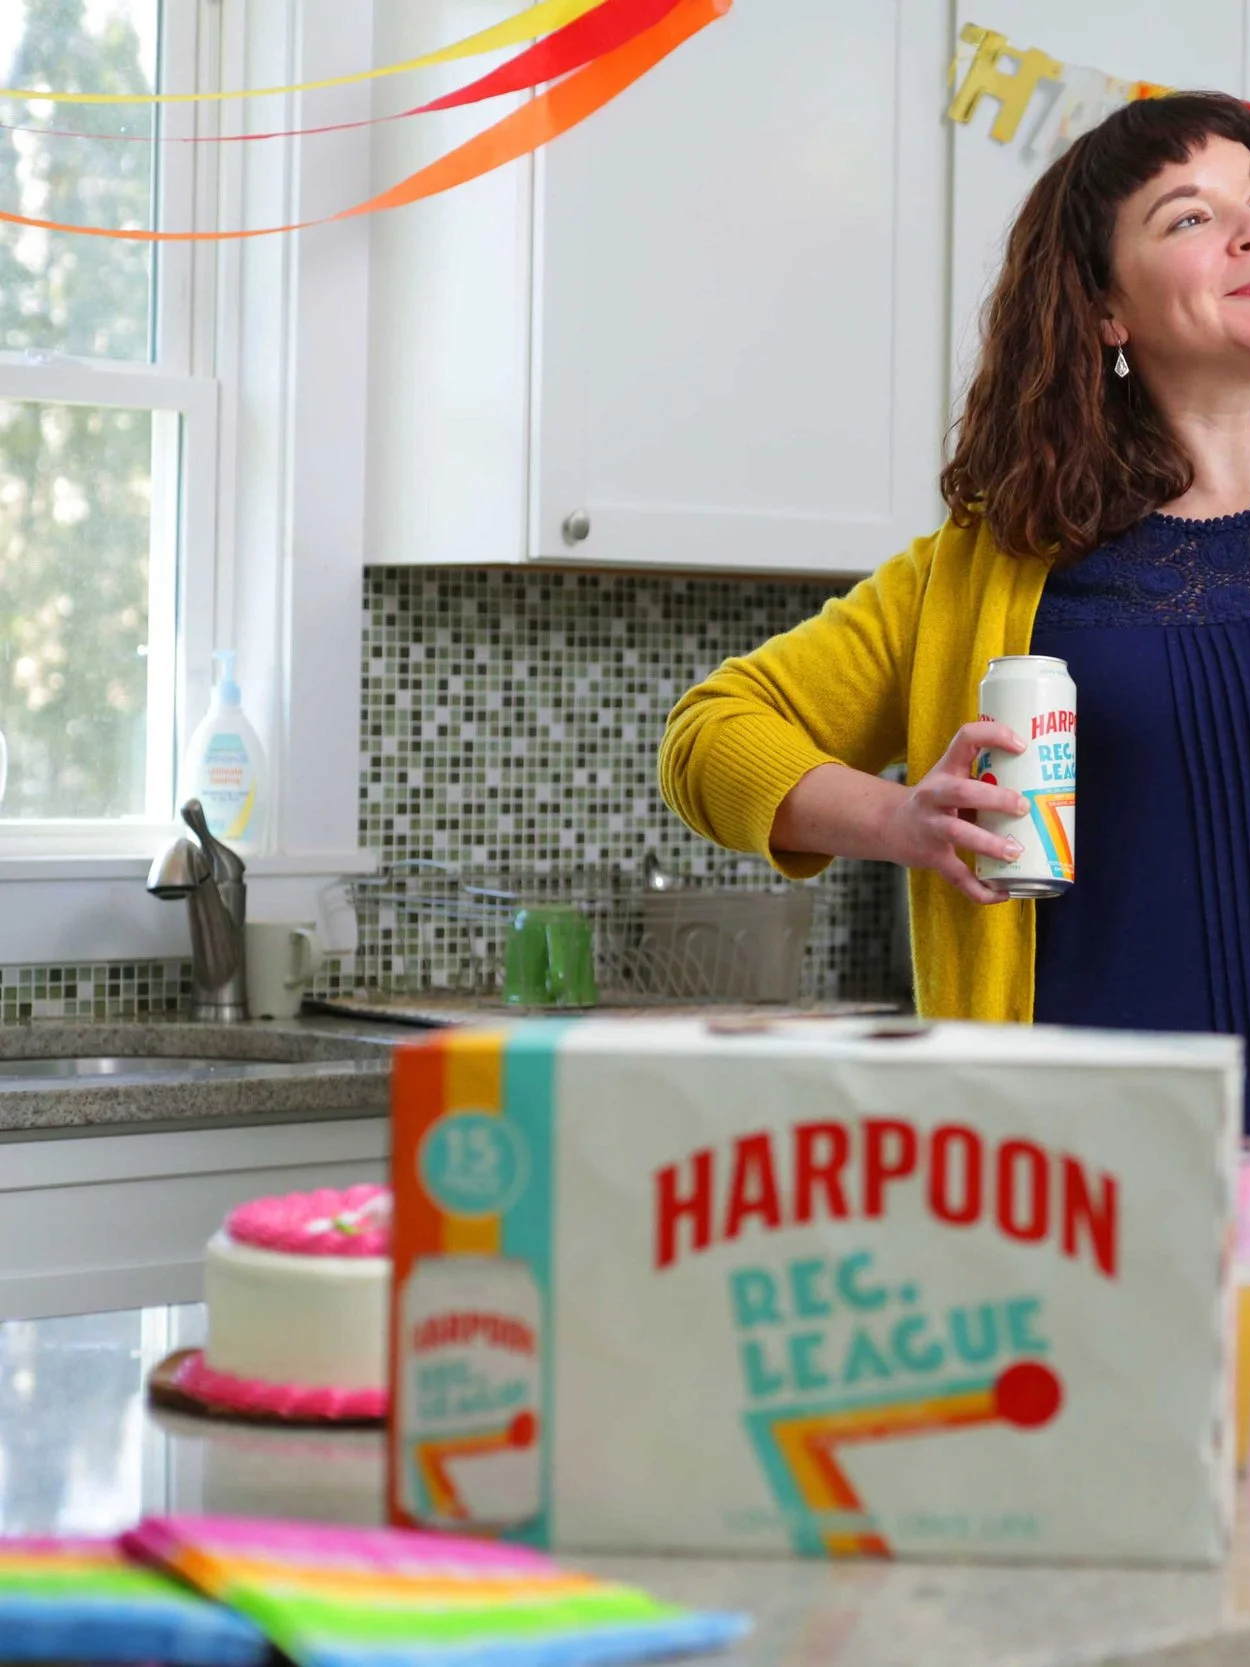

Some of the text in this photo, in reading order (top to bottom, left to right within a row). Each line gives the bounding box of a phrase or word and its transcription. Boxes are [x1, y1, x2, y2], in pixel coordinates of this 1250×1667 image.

[447, 1126, 501, 1173] 15
[653, 1116, 1118, 1282] HARPOON
[729, 1250, 920, 1330] REC.
[740, 1295, 1050, 1398] LEAGUE
